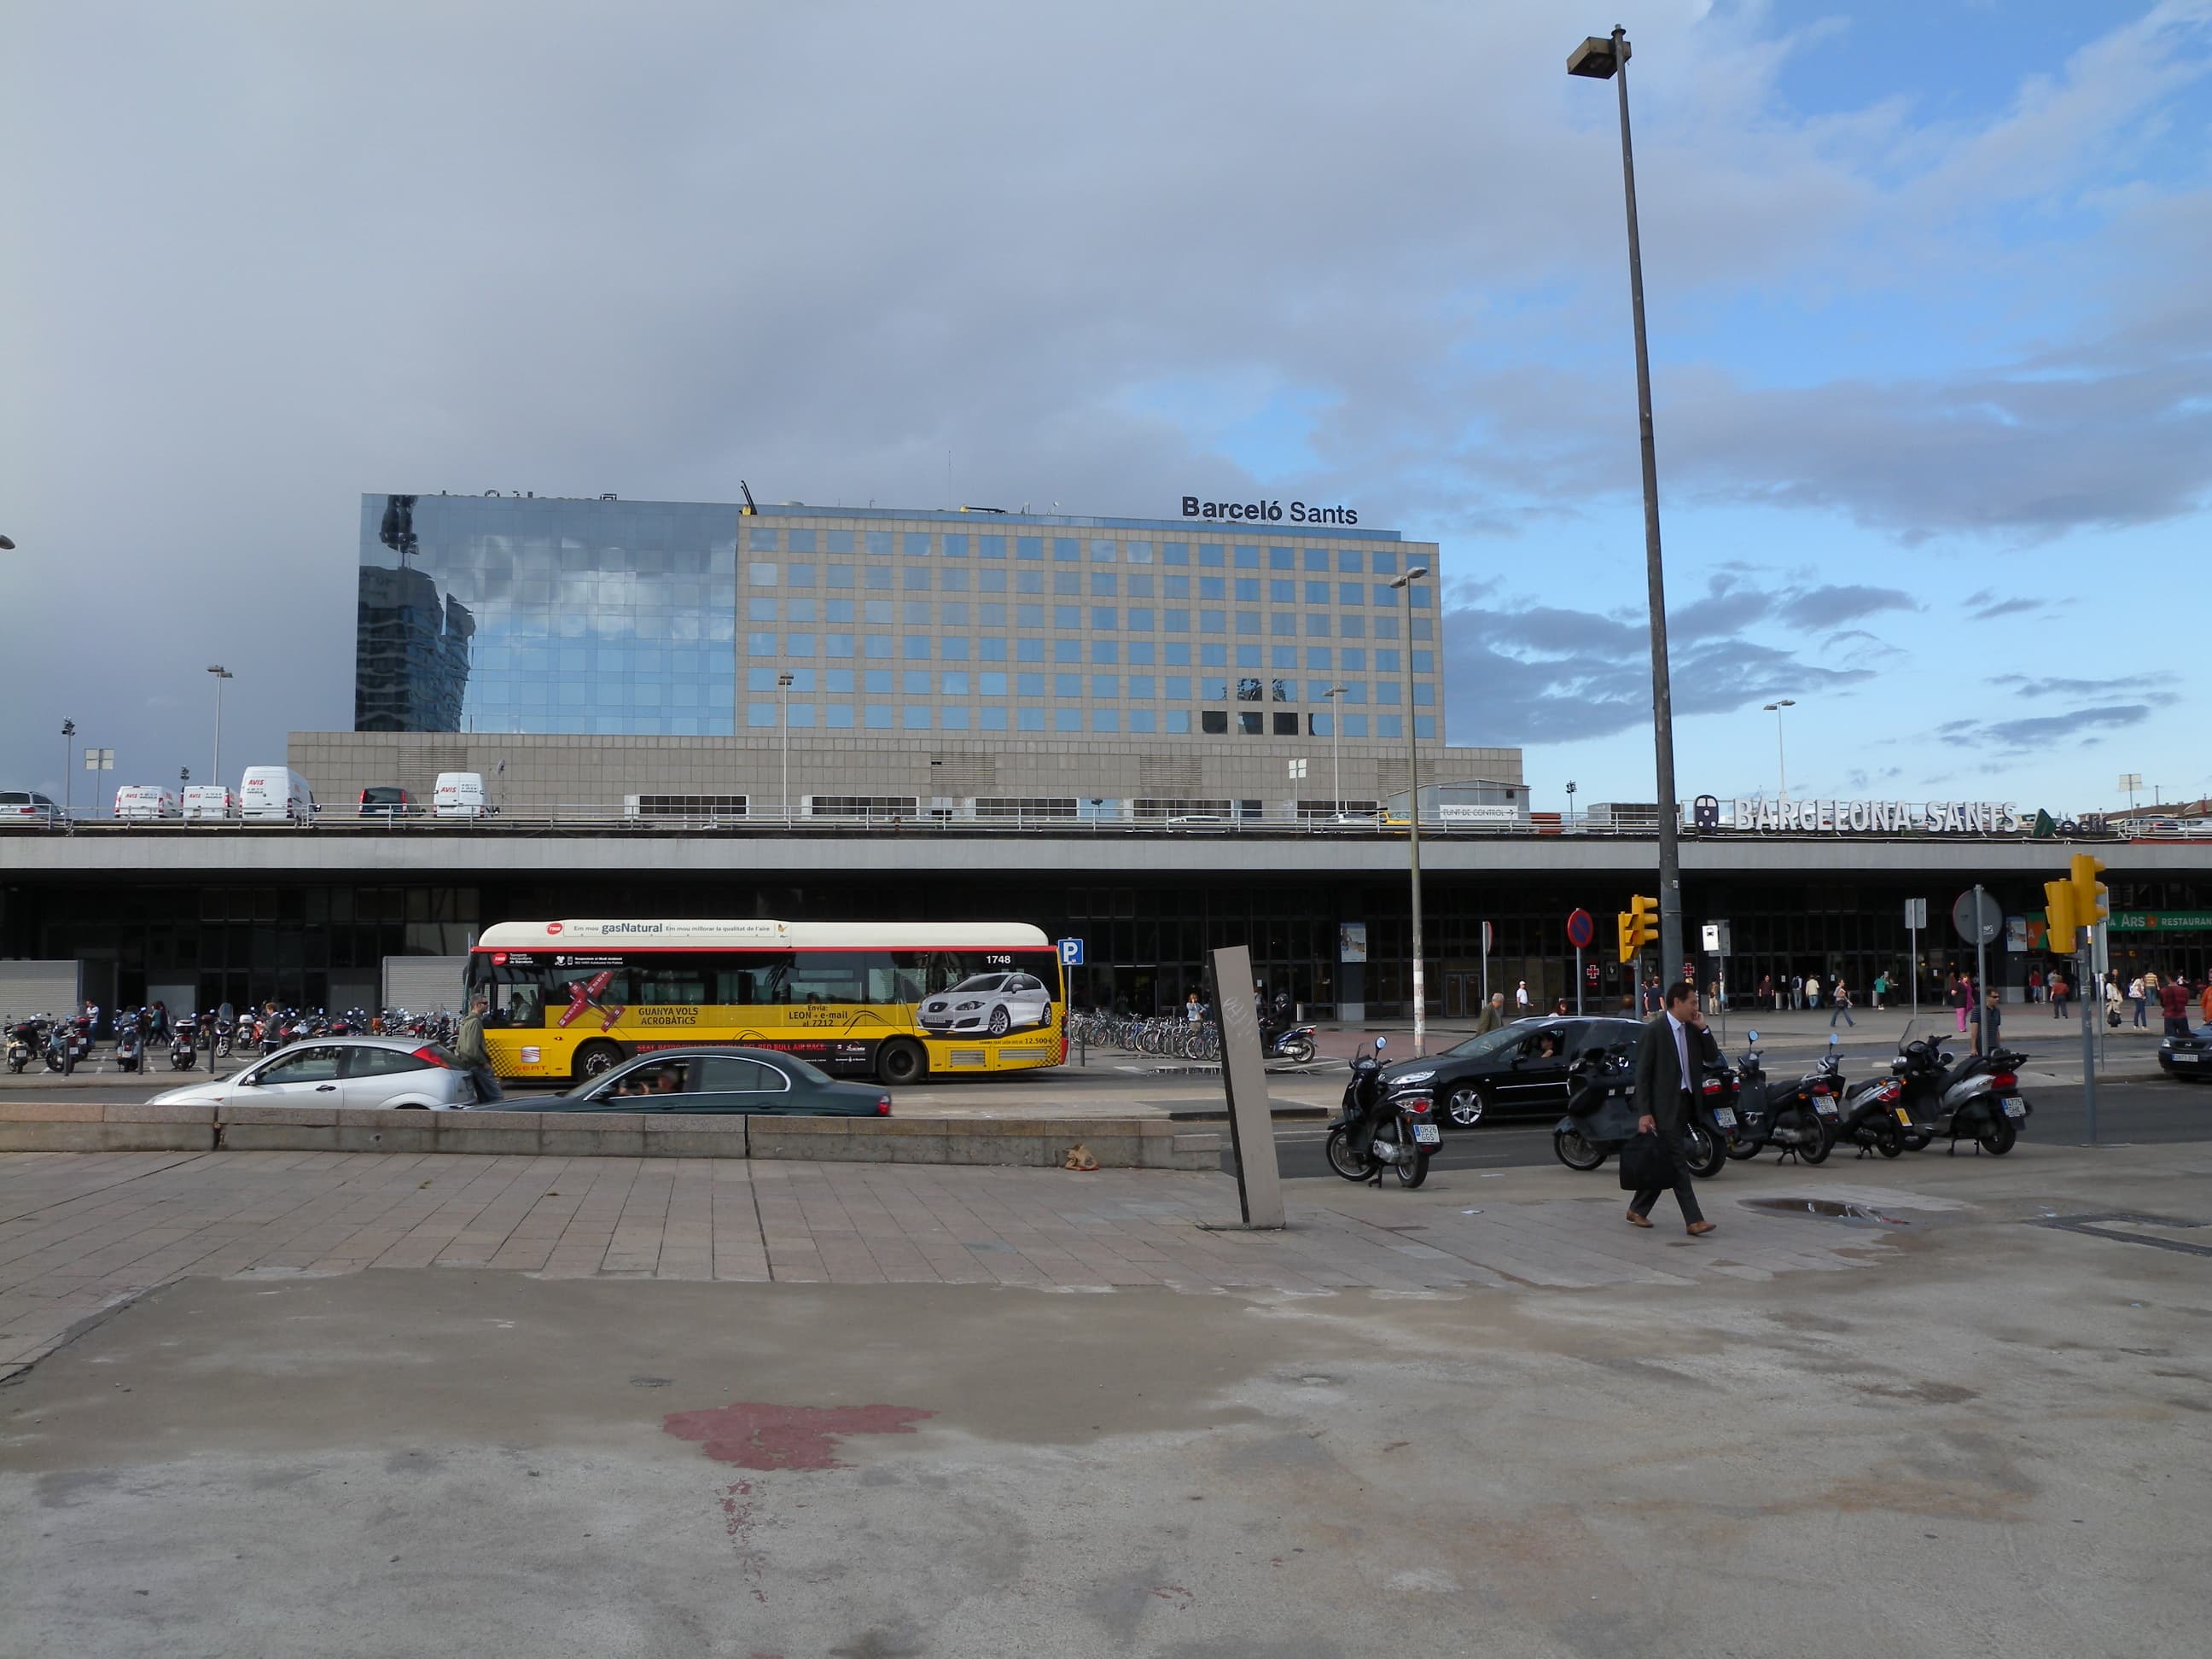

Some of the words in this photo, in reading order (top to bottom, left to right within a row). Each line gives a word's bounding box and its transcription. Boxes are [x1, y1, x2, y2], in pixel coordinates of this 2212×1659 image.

[1182, 497, 1283, 521] Barceló
[1289, 502, 1358, 525] Sants
[1734, 799, 1911, 832] BARCELONA
[1926, 800, 2019, 833] SANTS
[2122, 914, 2145, 927] ARS
[602, 923, 662, 934] gasNatural
[723, 925, 745, 934] qualitat
[1063, 942, 1078, 963] P
[986, 955, 1011, 963] 1748
[638, 1007, 673, 1016] GUANYA
[676, 1007, 698, 1016] VOLS
[641, 1016, 696, 1024] ACROBÀTICS
